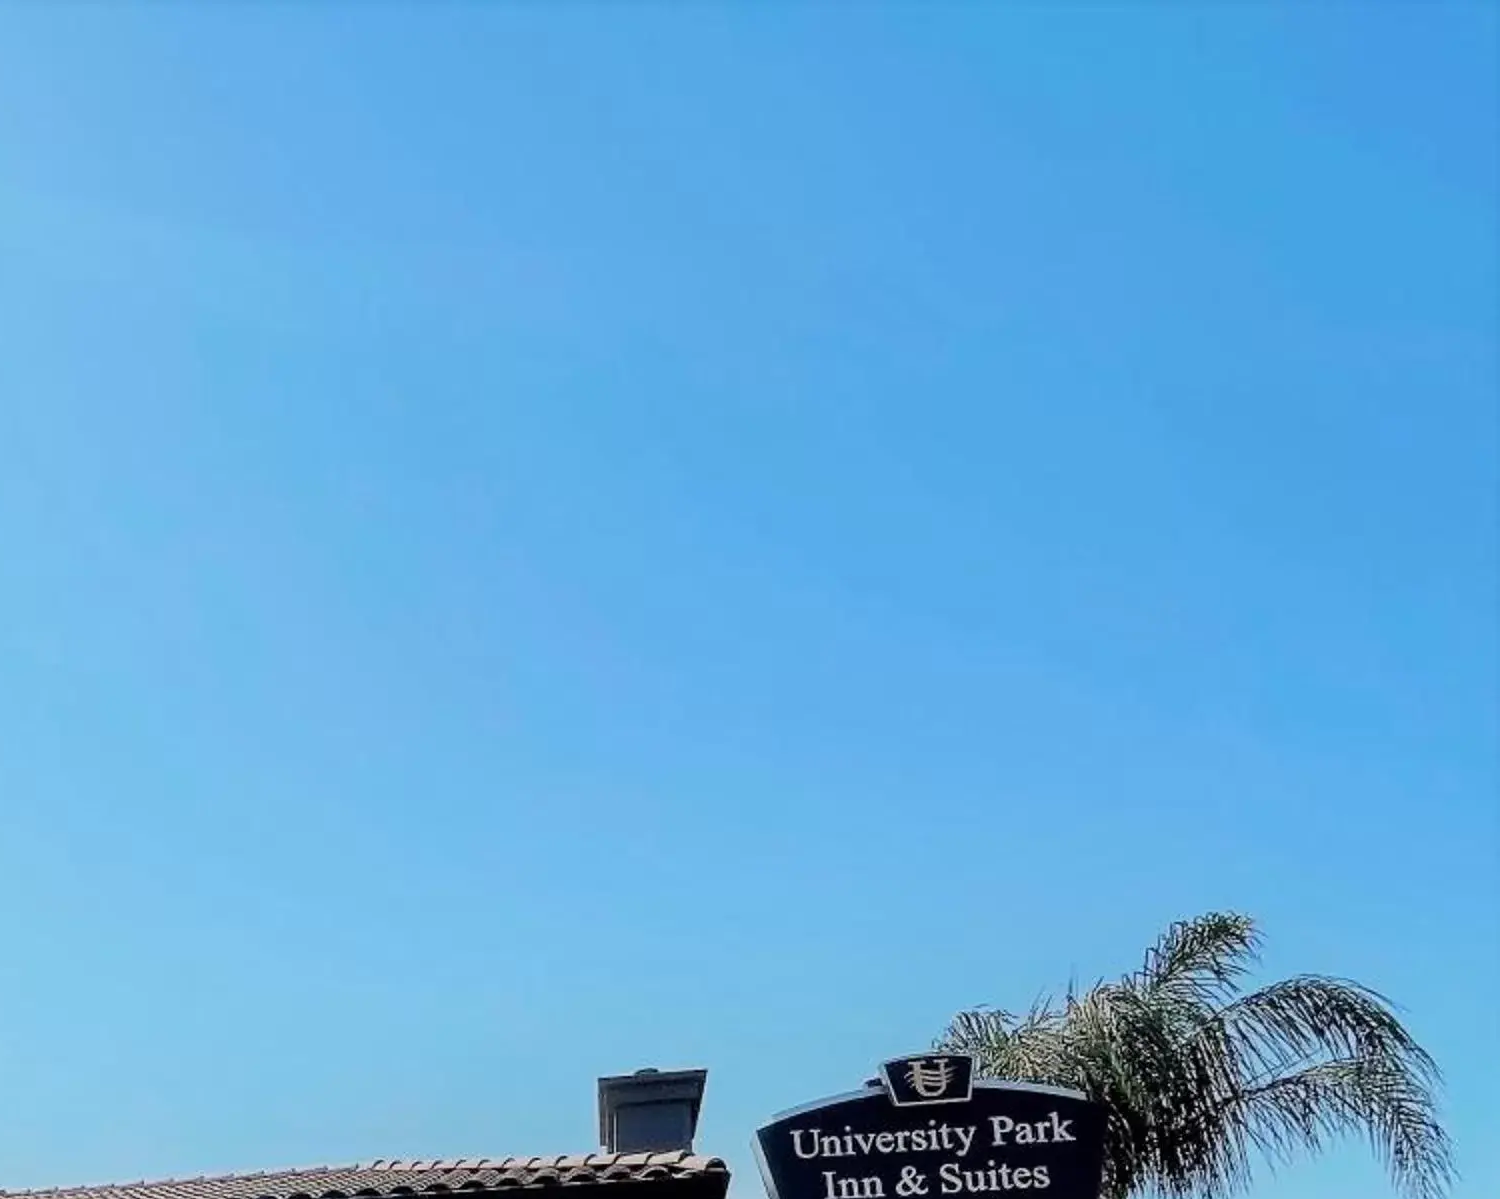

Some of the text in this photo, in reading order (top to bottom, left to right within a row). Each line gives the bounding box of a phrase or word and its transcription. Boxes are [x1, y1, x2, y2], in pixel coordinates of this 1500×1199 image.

[790, 1111, 1077, 1159] University Park
[822, 1159, 1051, 1199] Inn & Suites
